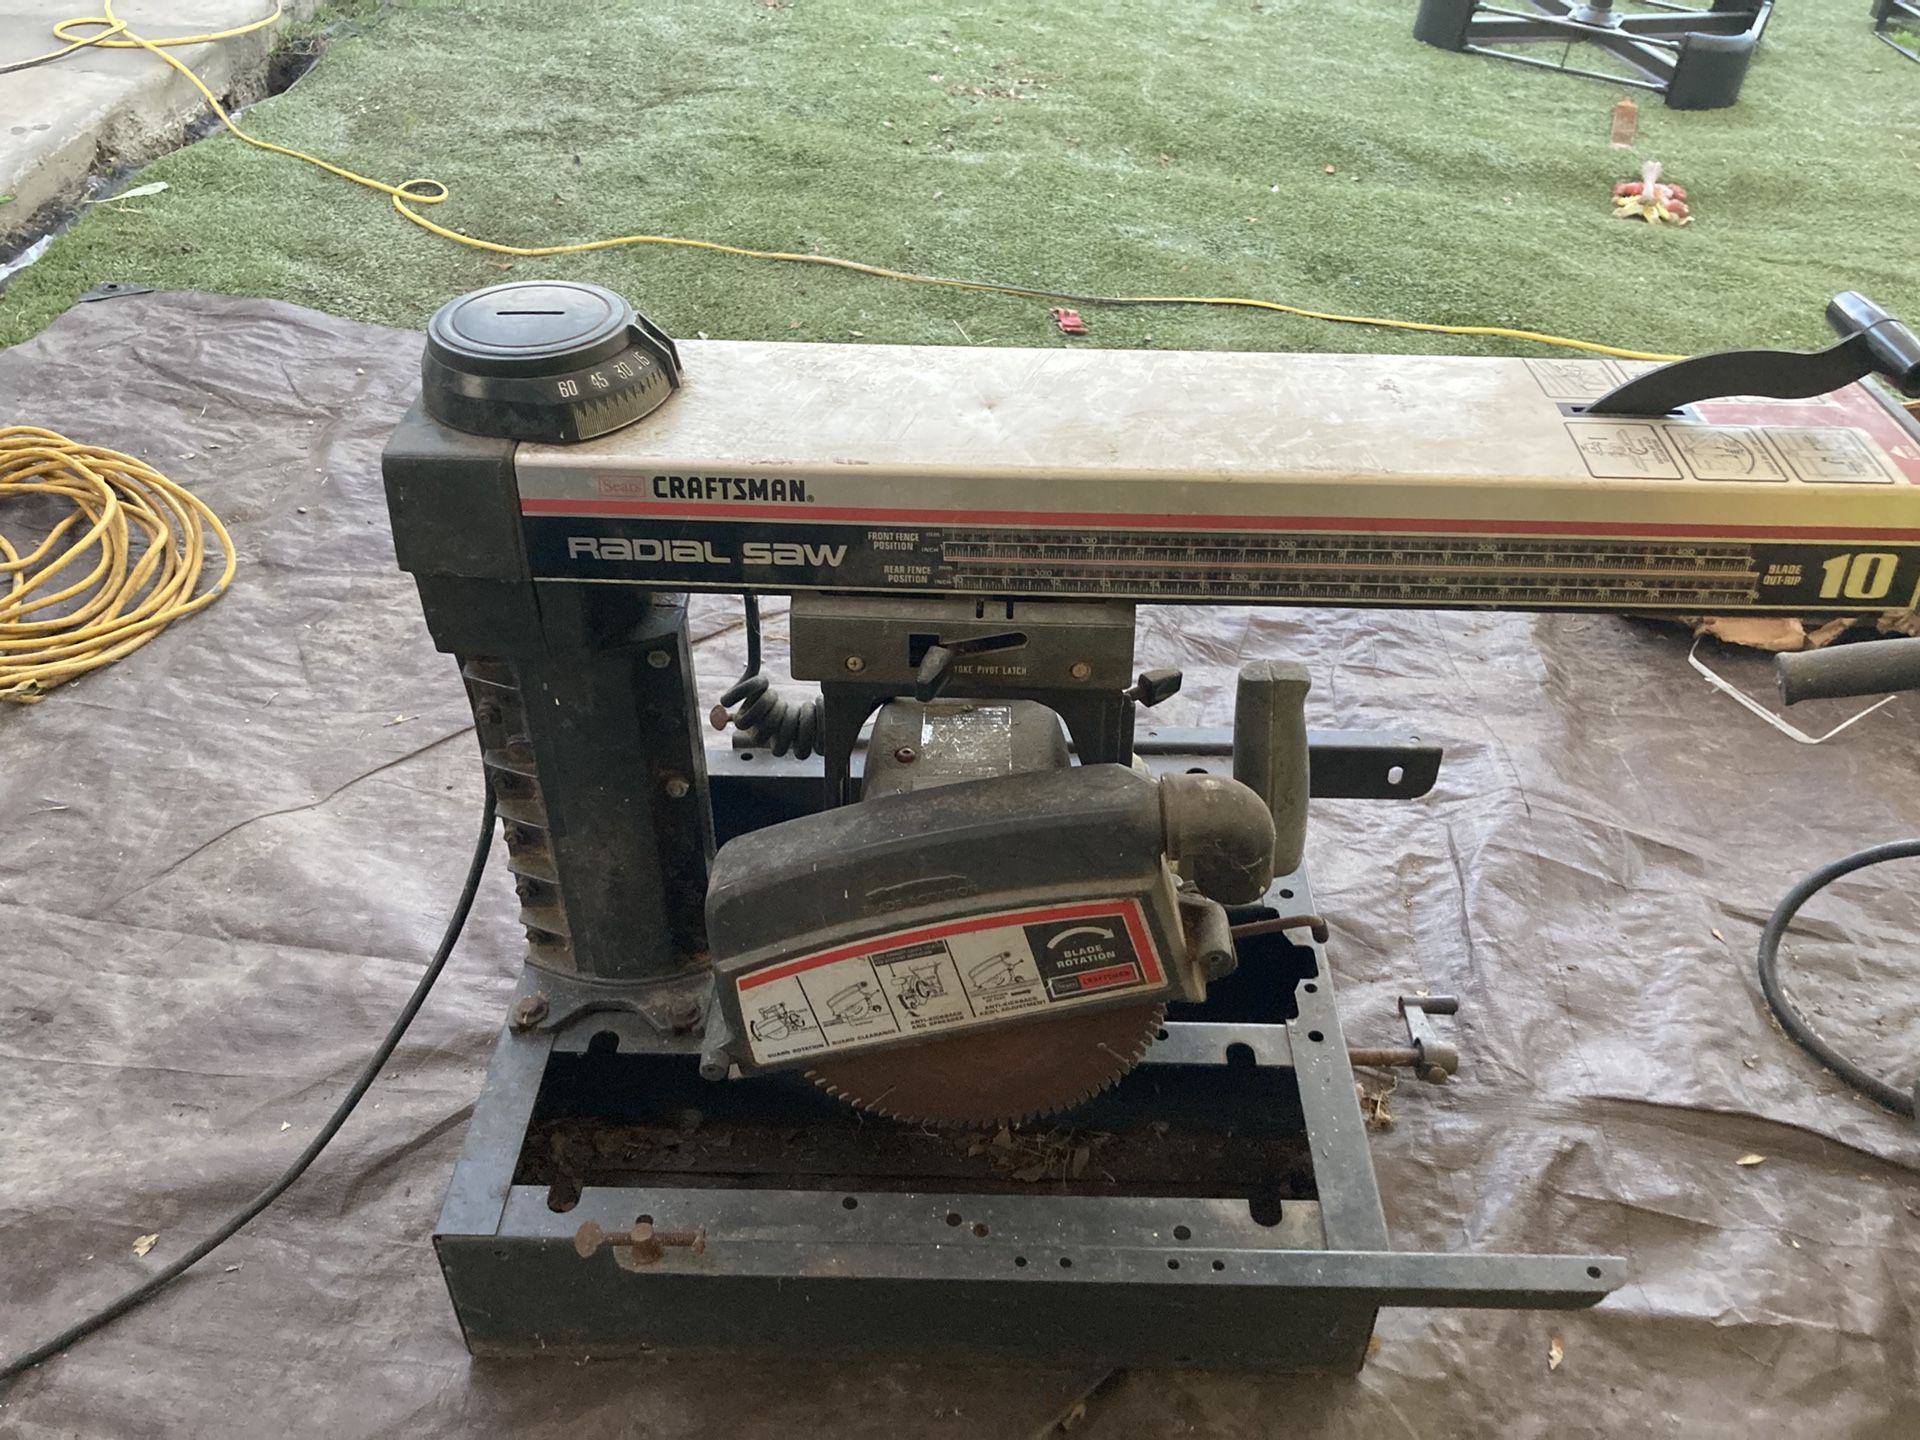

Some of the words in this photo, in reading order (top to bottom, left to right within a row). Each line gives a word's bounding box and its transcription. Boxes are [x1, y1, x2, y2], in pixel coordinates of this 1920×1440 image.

[557, 380, 579, 398] 60
[590, 371, 609, 389] 45
[613, 361, 634, 379] 30
[867, 531, 894, 541] FRONT
[895, 532, 920, 542] FENCE
[873, 541, 914, 551] POSITION
[883, 565, 905, 574] REAR
[907, 566, 932, 575] FENCE
[1768, 564, 1802, 575] BLADE
[887, 575, 928, 584] POSITION
[1762, 575, 1802, 586] OUT-RIP
[1819, 553, 1899, 598] 10
[954, 665, 973, 674] YOKE
[976, 665, 999, 675] PIVOT
[1002, 666, 1027, 675] LATCH
[1063, 944, 1104, 959] BLADE
[1056, 950, 1116, 969] ROTATION
